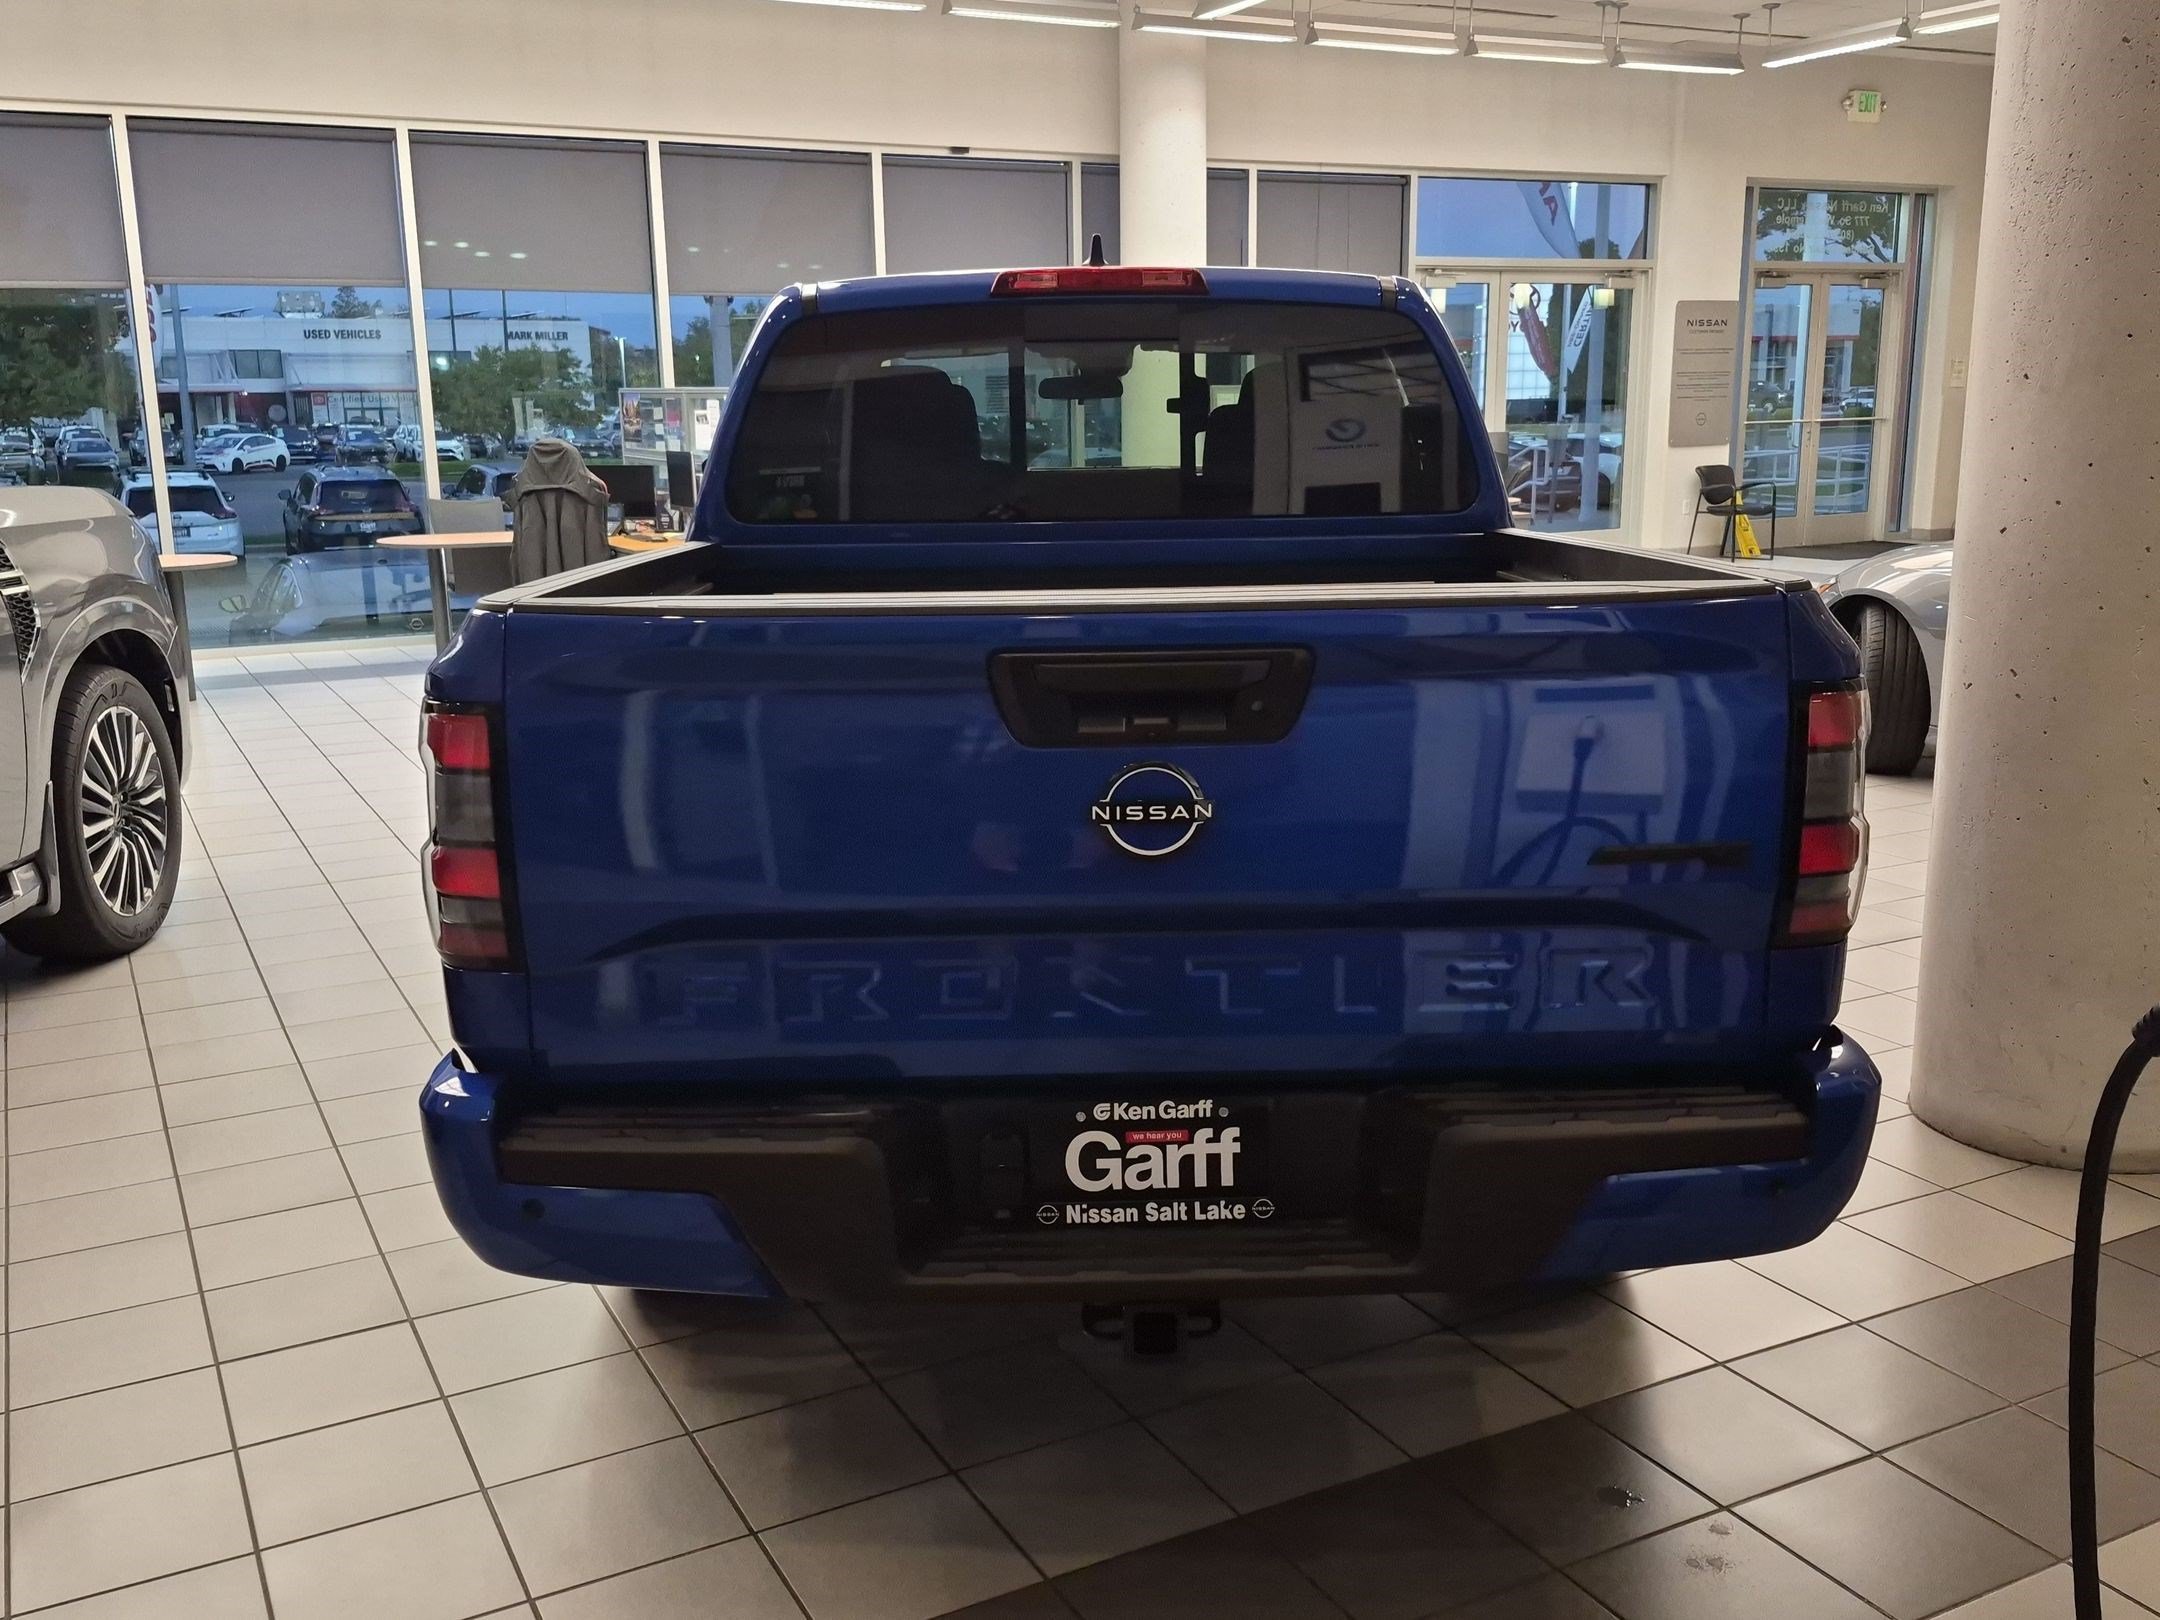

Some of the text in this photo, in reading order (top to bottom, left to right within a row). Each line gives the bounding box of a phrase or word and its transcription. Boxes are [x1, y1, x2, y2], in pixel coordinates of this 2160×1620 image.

[1858, 93, 1878, 112] EXIT
[1686, 319, 1728, 327] NISSAN
[303, 329, 382, 340] USED VEHICLES
[534, 331, 568, 341] MILLER
[1091, 802, 1213, 821] NISSAN
[1113, 1099, 1213, 1121] Ken Garff
[1132, 1131, 1183, 1142] we hear you
[1064, 1126, 1241, 1192] Garff
[1066, 1200, 1246, 1224] Nissan Salt Lake
